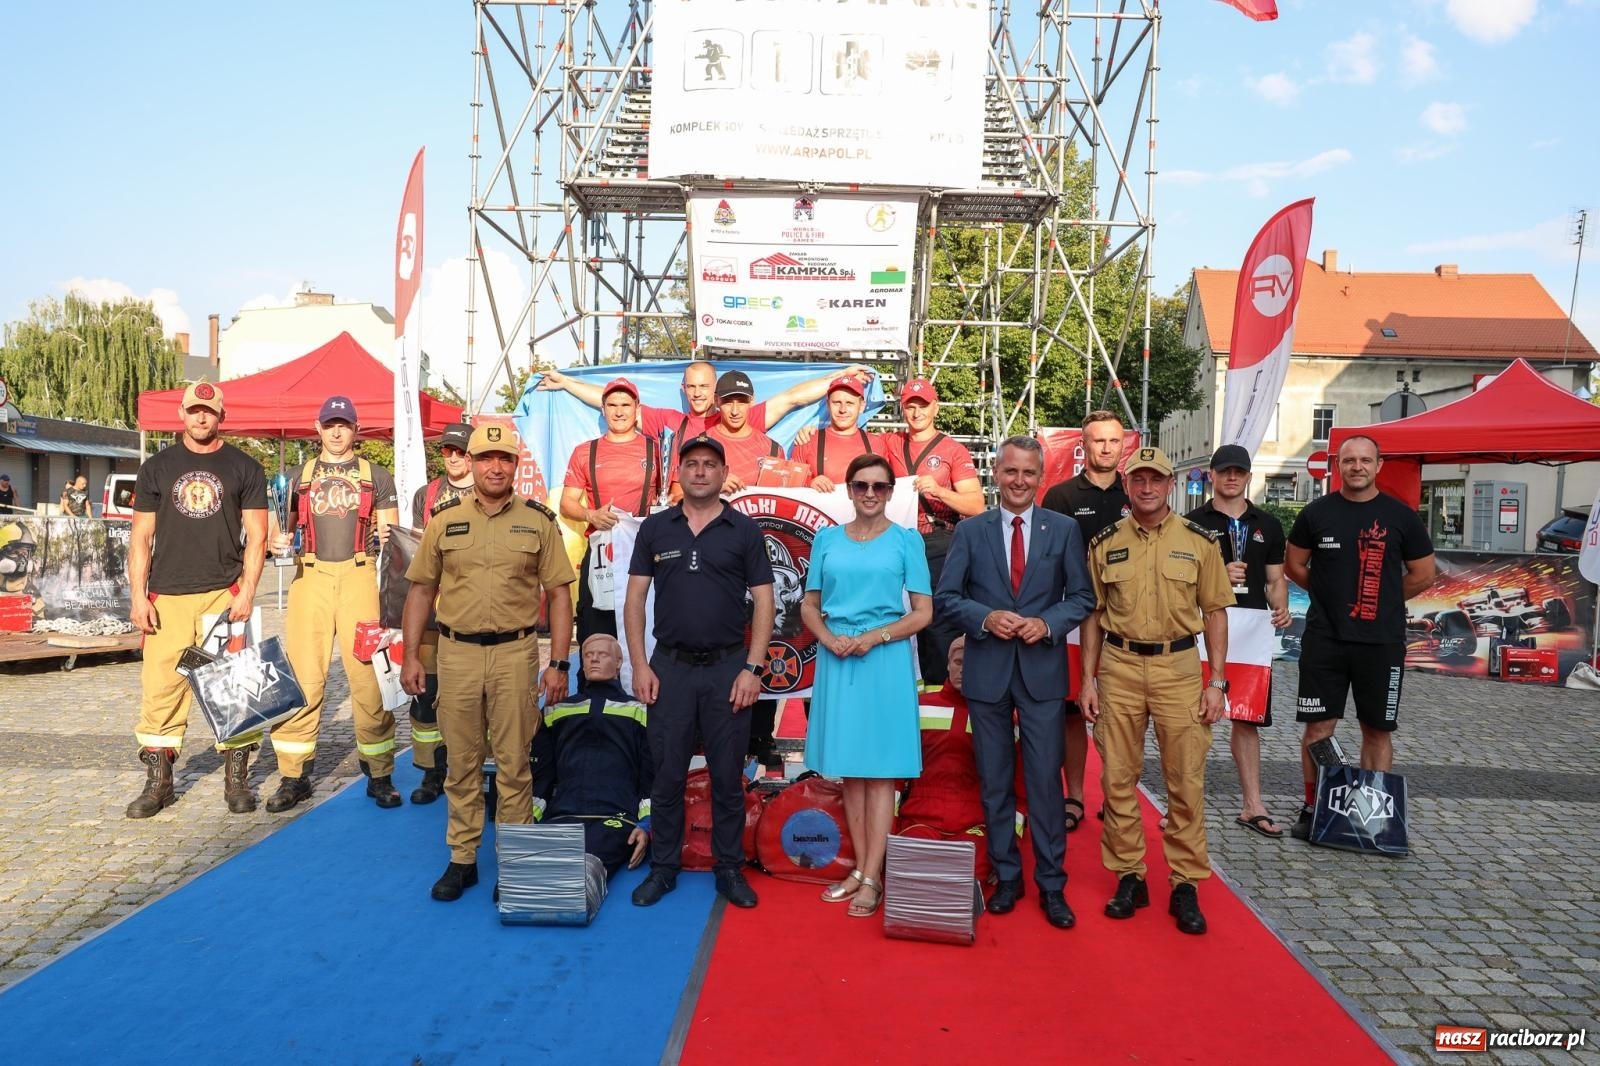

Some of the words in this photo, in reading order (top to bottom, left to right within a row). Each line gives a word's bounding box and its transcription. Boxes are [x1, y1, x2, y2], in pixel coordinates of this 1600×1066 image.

[777, 266, 838, 275] KAMPKA
[829, 298, 887, 308] KAREN
[1360, 541, 1386, 620] FIREFIGHTER
[64, 600, 121, 610] BEZPIECZNIE
[1298, 697, 1321, 706] TEAM
